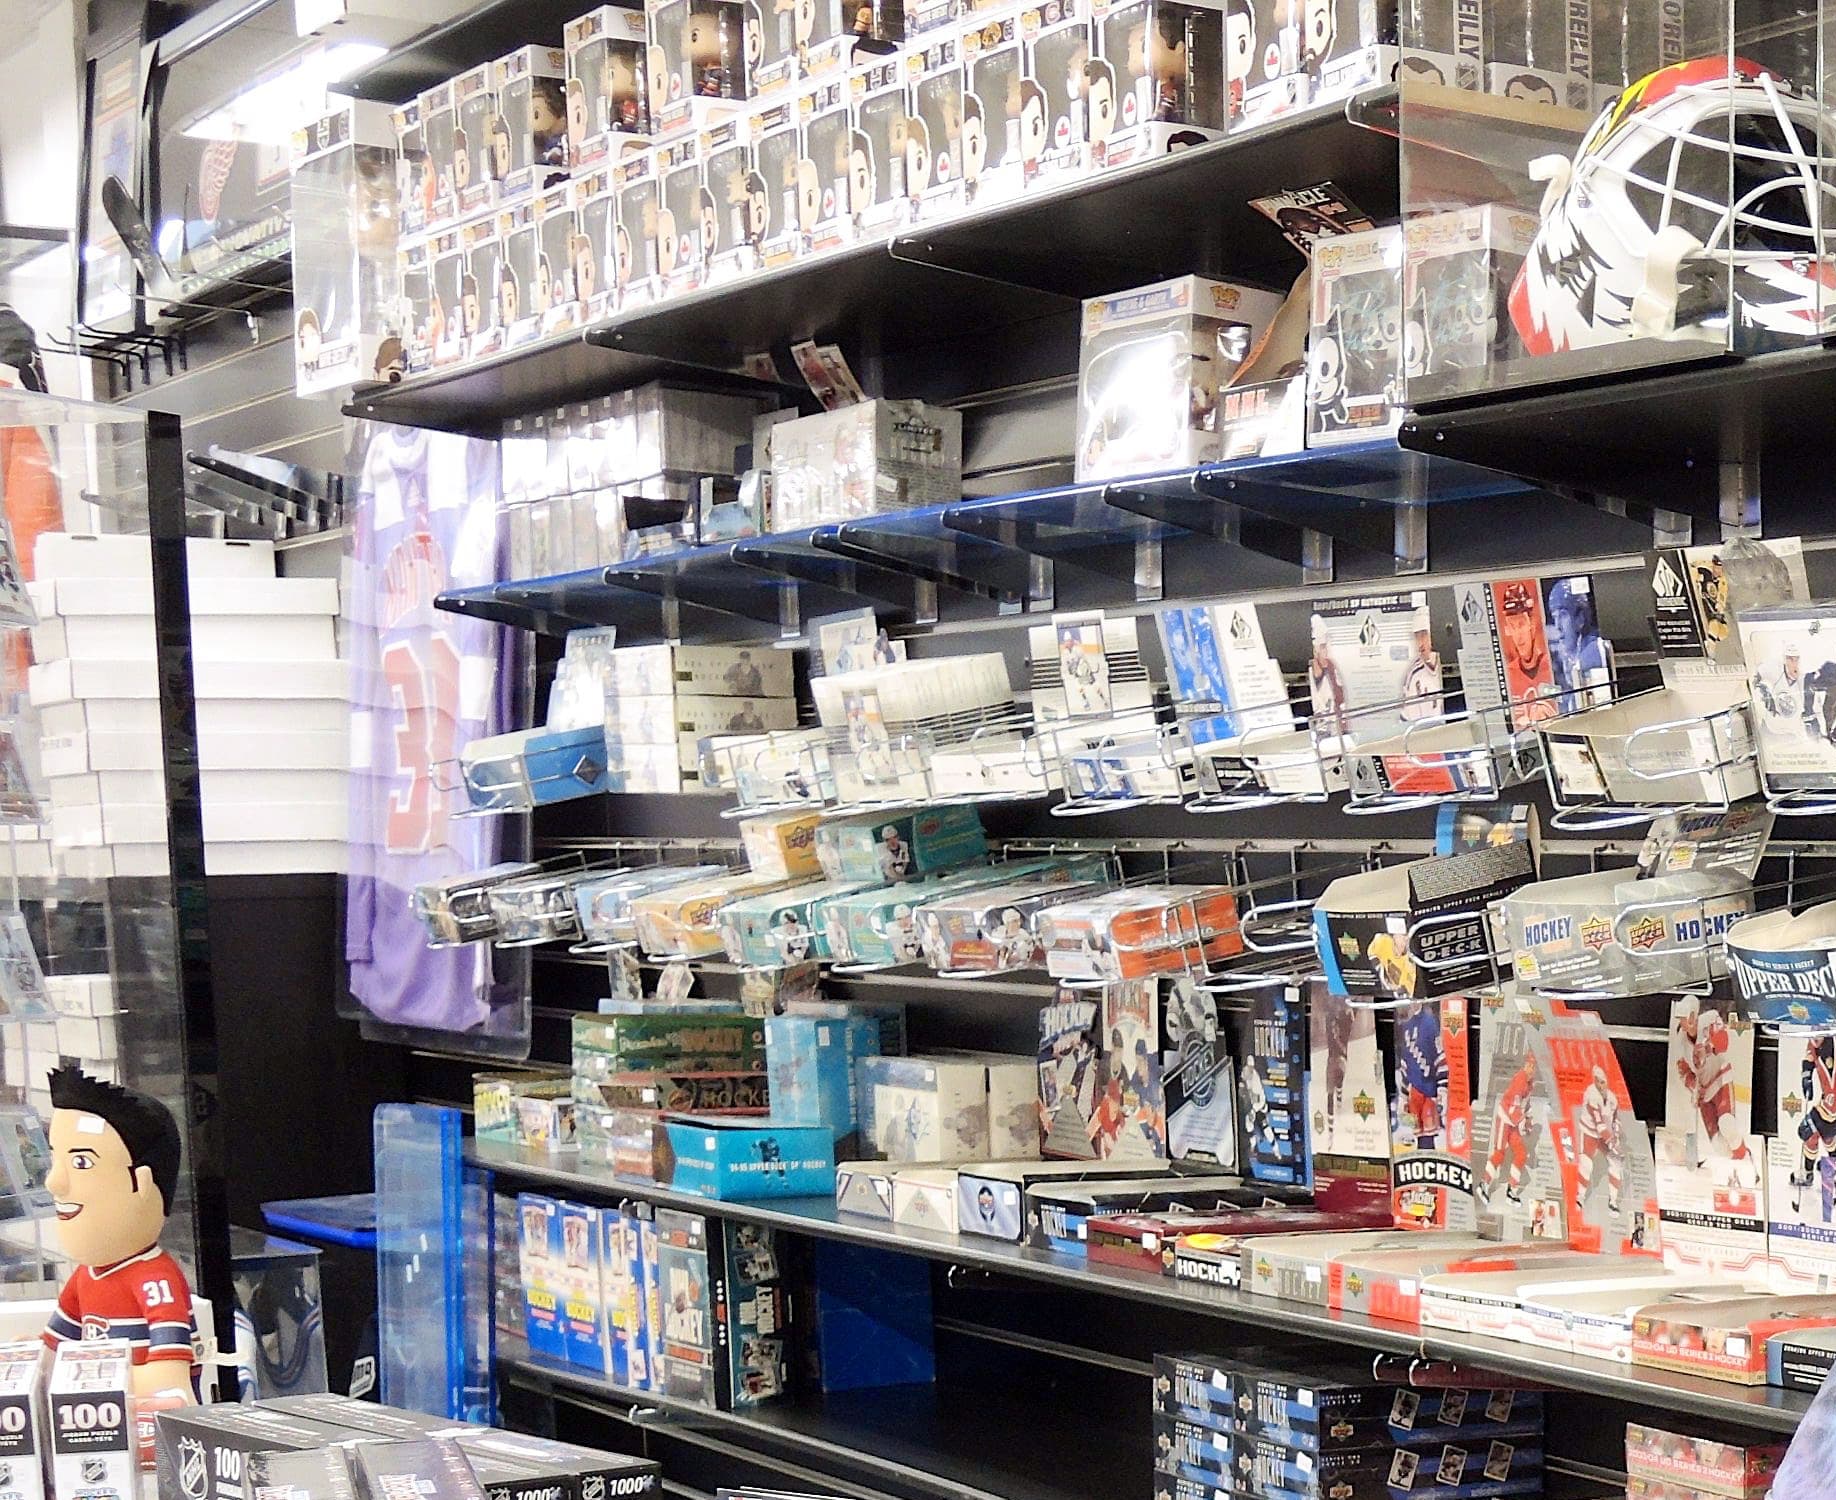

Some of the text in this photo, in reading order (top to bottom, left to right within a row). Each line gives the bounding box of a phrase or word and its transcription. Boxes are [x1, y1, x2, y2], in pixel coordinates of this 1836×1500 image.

[1420, 923, 1480, 947] UPPER
[1525, 916, 1572, 948] HOCKEY
[1733, 952, 1792, 1000] UPPER
[1399, 1163, 1474, 1192] HOCKEY
[140, 1278, 175, 1308] 31
[1715, 1353, 1748, 1366] HOCKEY
[57, 1401, 123, 1431] 100
[214, 1446, 242, 1482] 100
[610, 1475, 643, 1498] 1000
